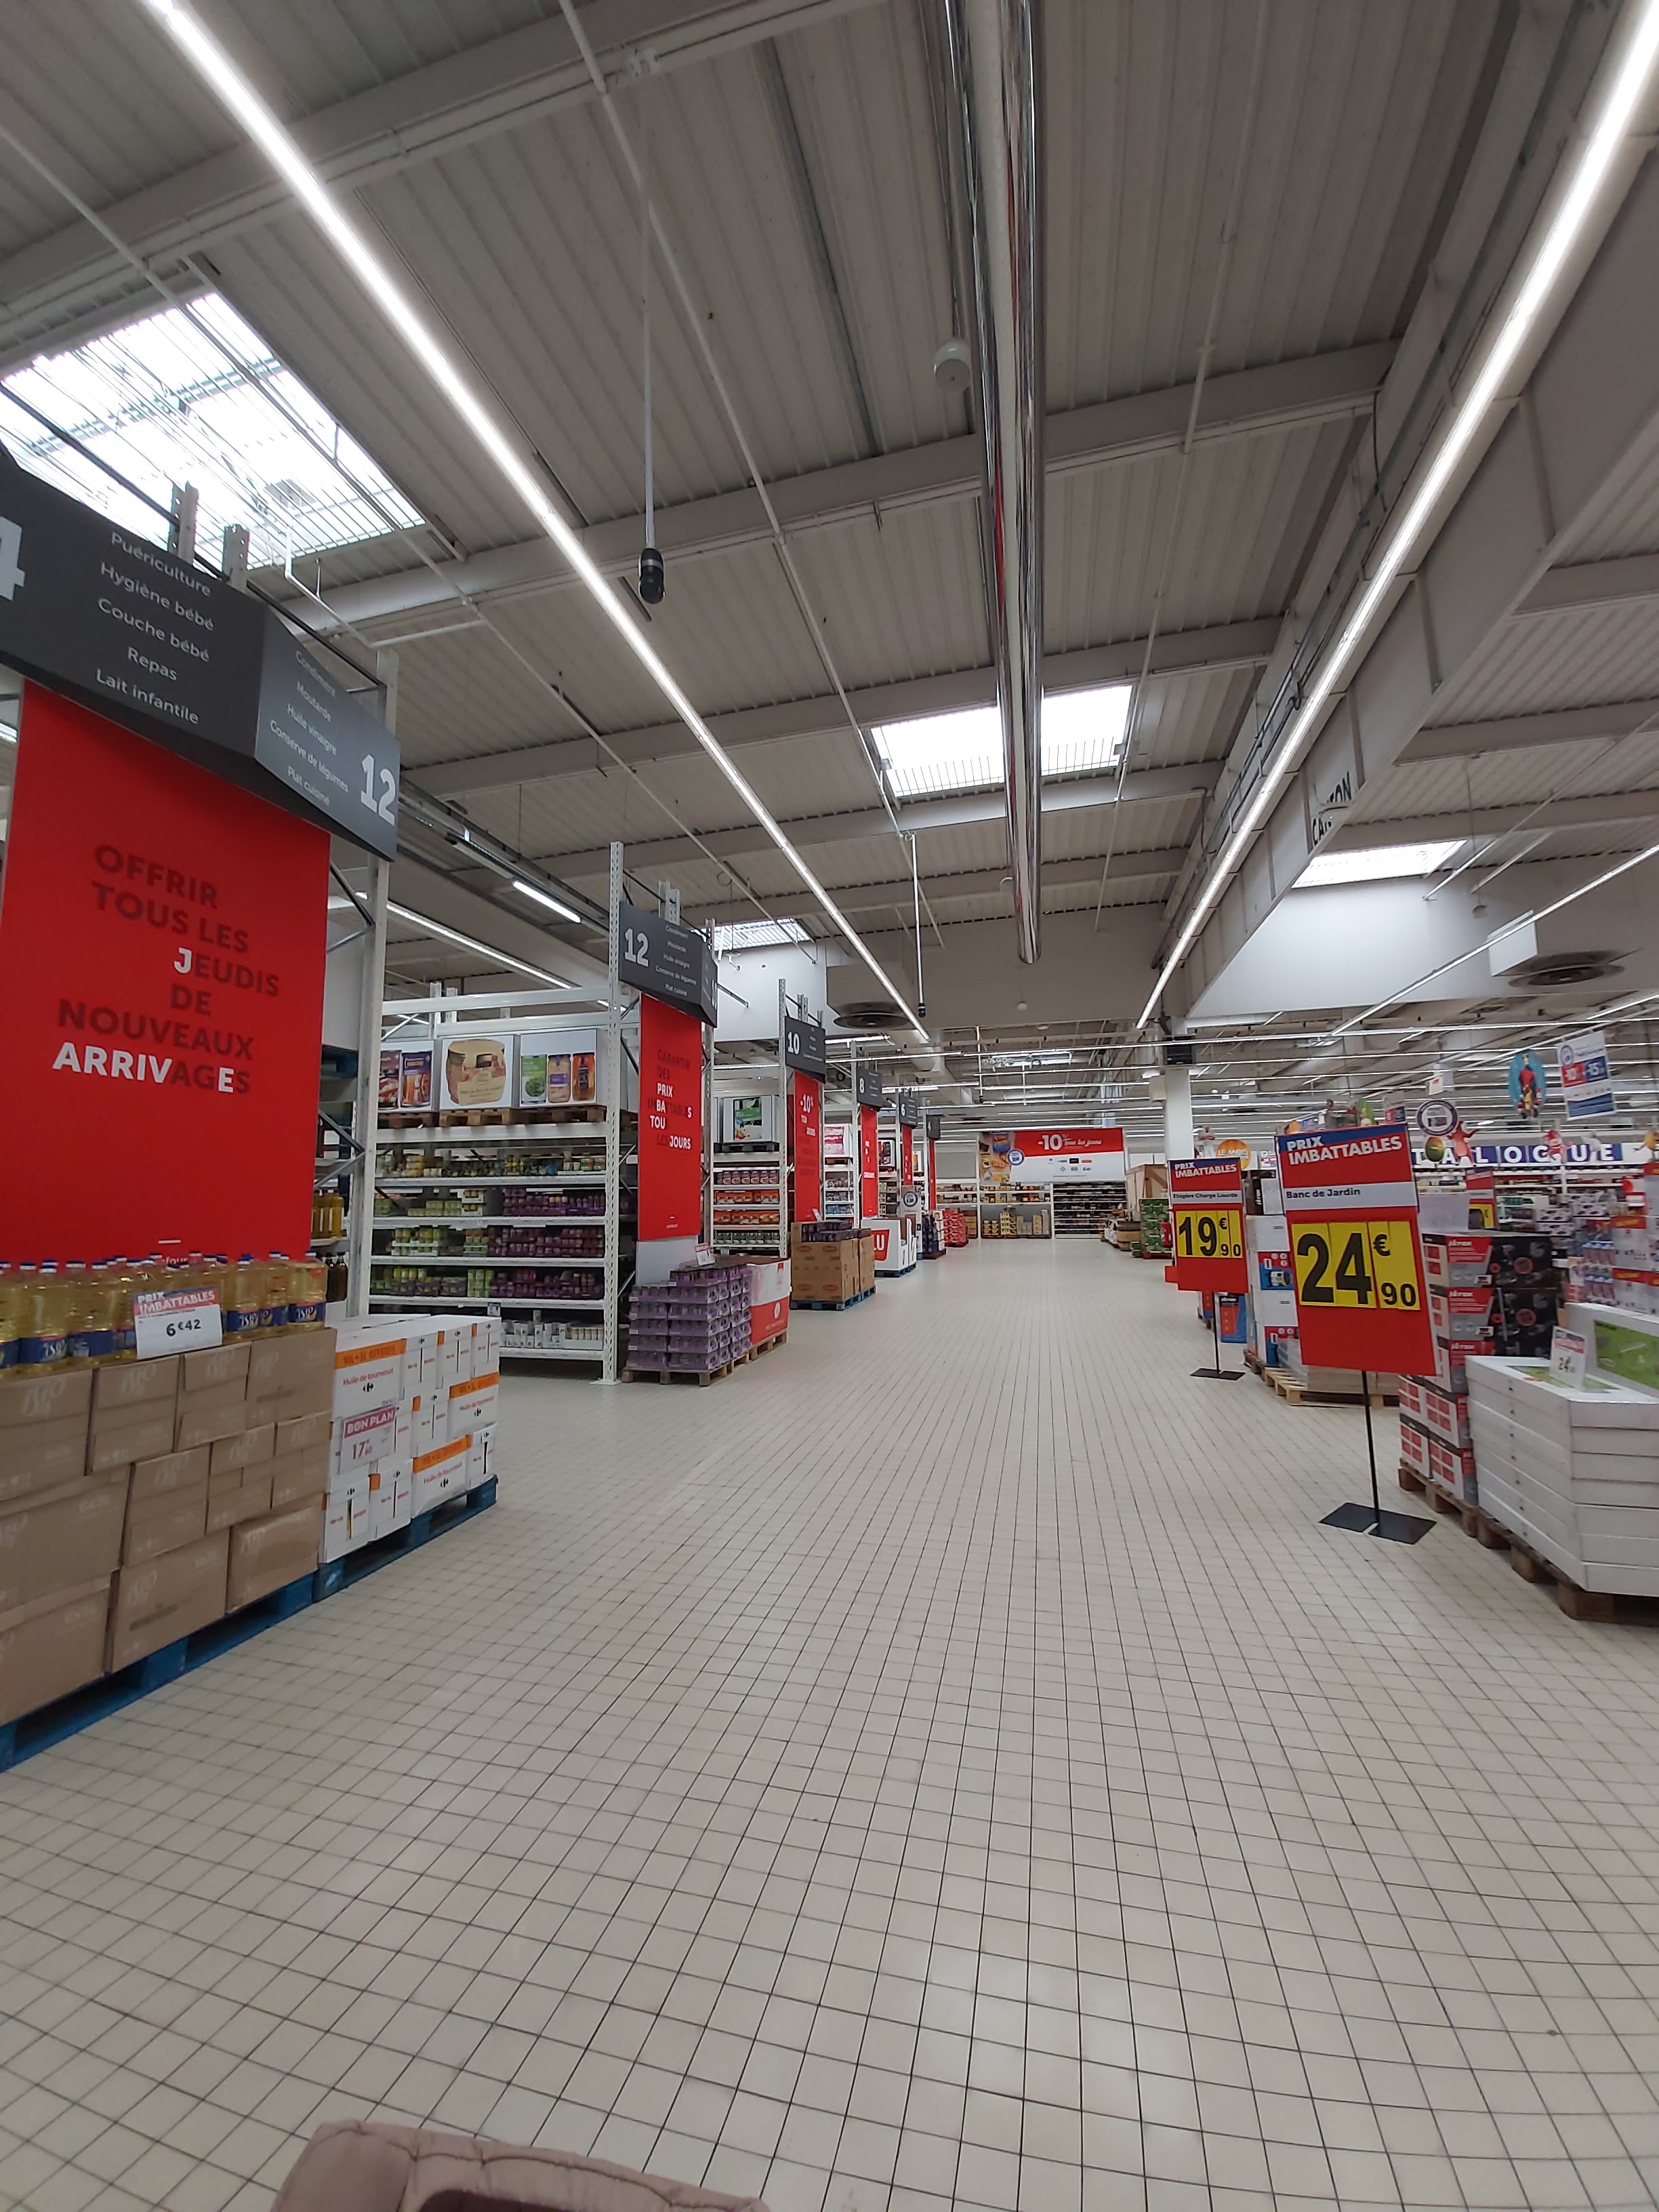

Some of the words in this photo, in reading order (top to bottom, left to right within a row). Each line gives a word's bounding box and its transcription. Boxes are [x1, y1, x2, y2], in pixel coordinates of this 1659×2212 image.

[112, 531, 211, 597] Puériculture
[101, 562, 170, 609] Hygiène
[175, 600, 213, 631] bébé
[98, 598, 165, 641] Couche
[170, 633, 209, 662] bébé
[128, 647, 178, 681] Repas
[96, 669, 128, 694] Lait
[133, 684, 199, 724] infantile
[297, 681, 332, 722] Moutarde
[270, 720, 306, 758] Conserve
[307, 754, 318, 767] de
[287, 703, 307, 729] Huile
[308, 726, 337, 756] vinaigre
[288, 766, 302, 785] Plat
[361, 754, 396, 826] 12
[95, 844, 218, 909] OFFRIR
[90, 881, 189, 935] TOUS
[199, 918, 249, 954] LES
[624, 928, 649, 968] 12
[173, 947, 280, 997] JEUDIS
[170, 984, 211, 1016] DE
[58, 998, 254, 1060] NOUVEAUX
[787, 1031, 800, 1055] 10
[52, 1042, 250, 1094] ARRIVAGES
[657, 1082, 673, 1099] PRIX
[859, 1078, 865, 1094] 8
[901, 1104, 906, 1117] 6
[669, 1135, 691, 1150] JOURS
[1286, 1136, 1324, 1151] PRIX
[1288, 1136, 1403, 1165] IMBATTABLES
[1174, 1162, 1195, 1170] PRIX
[1175, 1164, 1237, 1178] IMBATTABLES
[1286, 1191, 1310, 1199] Banc
[1312, 1189, 1325, 1197] de
[1327, 1187, 1361, 1197] Jardin
[138, 1292, 165, 1303] PRIX
[139, 1290, 216, 1315] IMBATTABLES
[343, 1376, 359, 1387] Huile
[370, 1410, 394, 1427] PLAN
